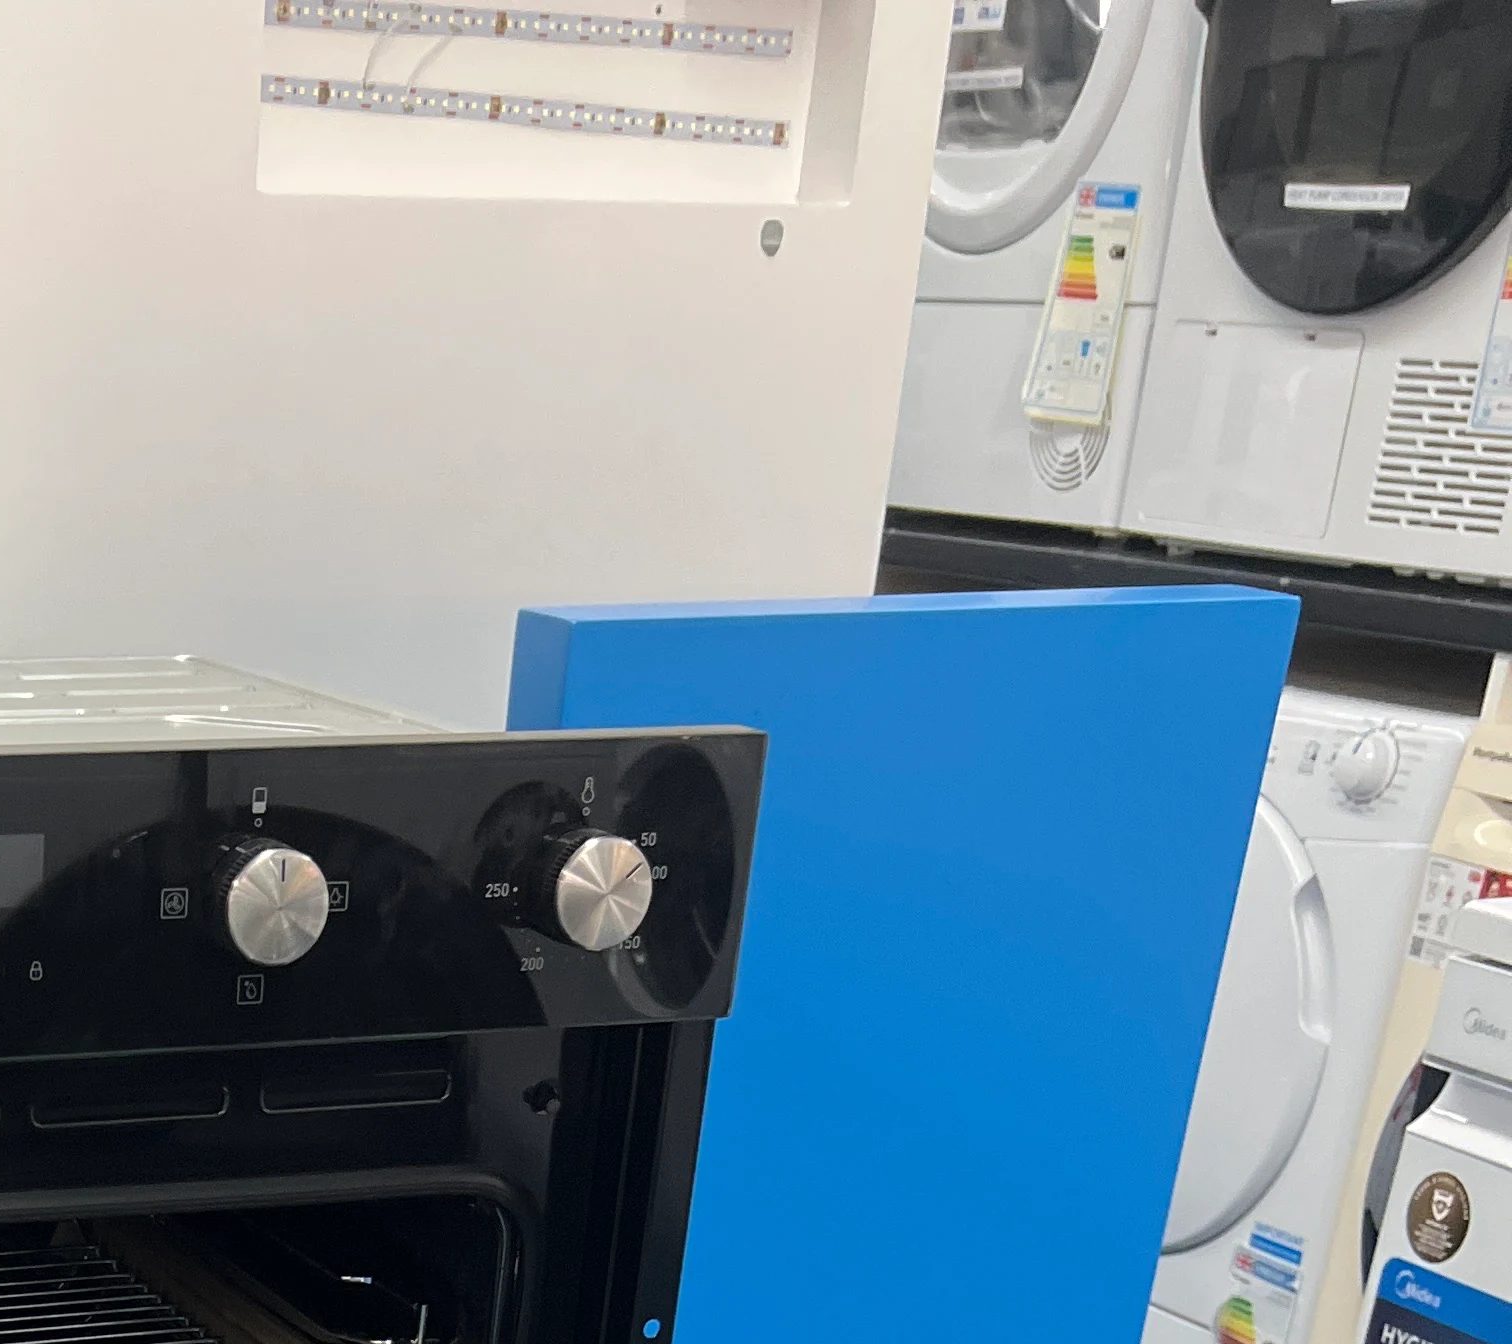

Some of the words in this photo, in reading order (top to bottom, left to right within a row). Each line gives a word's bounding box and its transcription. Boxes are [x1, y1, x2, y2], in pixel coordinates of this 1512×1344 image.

[641, 832, 657, 847] 50
[652, 865, 668, 880] 00
[485, 883, 510, 898] 250
[520, 957, 544, 972] 200
